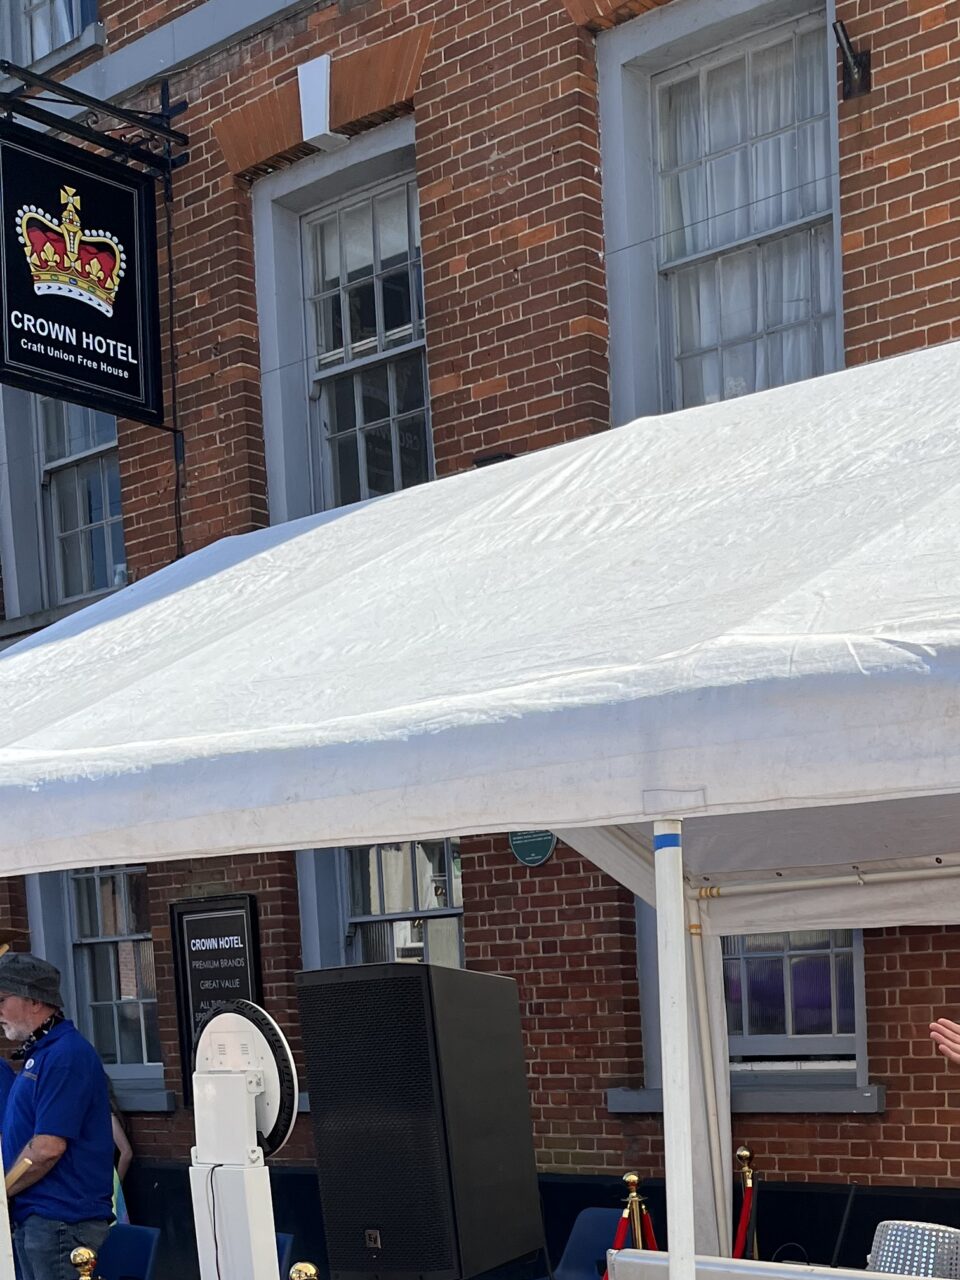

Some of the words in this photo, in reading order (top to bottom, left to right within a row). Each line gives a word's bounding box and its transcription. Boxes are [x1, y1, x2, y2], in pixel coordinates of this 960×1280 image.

[10, 310, 77, 346] CROWN
[82, 333, 138, 365] HOTEL
[20, 338, 45, 354] Craft
[47, 345, 75, 363] Union
[78, 353, 98, 370] Free
[100, 361, 129, 379] House
[191, 938, 218, 951] CROWN
[219, 936, 243, 948] HOTEL
[192, 960, 219, 969] PREMIUM
[220, 958, 244, 967] BRANDS
[200, 980, 219, 989] GREAT
[221, 978, 240, 987] VALUE
